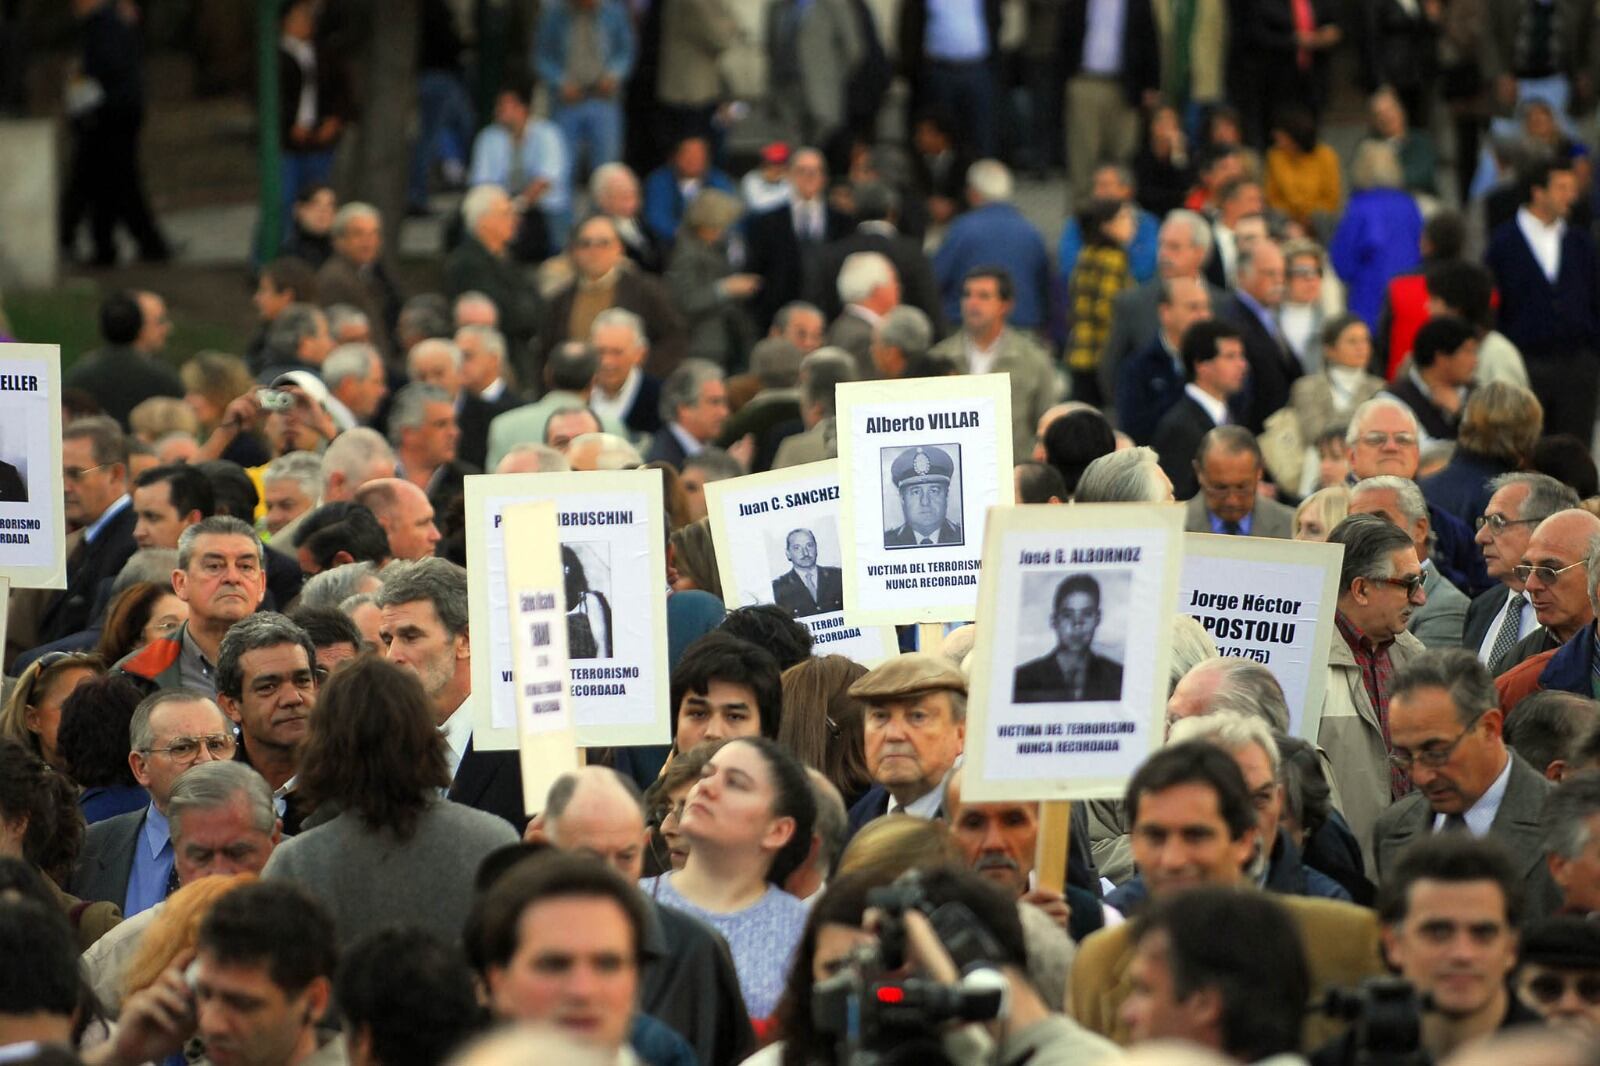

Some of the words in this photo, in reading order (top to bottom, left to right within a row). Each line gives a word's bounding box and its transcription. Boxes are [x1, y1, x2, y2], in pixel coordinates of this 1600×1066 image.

[0, 375, 38, 391] ELLER
[866, 416, 925, 433] Alberto
[927, 411, 980, 430] VILLAR
[739, 501, 769, 516] Juan
[771, 497, 784, 510] C.
[785, 485, 840, 508] SANCHEZ
[0, 518, 40, 530] RORISMO
[557, 510, 633, 526] BRUSCHINI
[0, 533, 30, 544] RDADA
[1070, 546, 1141, 563] ALBORNOZ
[867, 564, 908, 577] VICTIMA
[909, 563, 926, 574] DEL
[928, 560, 983, 573] TERRORISM
[885, 578, 918, 590] NUNCA
[920, 575, 977, 588] RECORDADA
[1190, 589, 1239, 611] Jorge
[1241, 594, 1302, 615] Héctor
[811, 616, 845, 631] TERROR
[813, 627, 861, 645] ECORDADA
[1215, 646, 1271, 664] 1/3/75)
[570, 667, 639, 680] TERRORISMO
[570, 684, 626, 697] ECORDADA
[997, 724, 1042, 737] VICTIMA
[1044, 723, 1063, 735] DEL
[1066, 721, 1136, 735] TERRORISMO
[1017, 741, 1053, 754] NUNCA
[1055, 739, 1120, 753] RECORDADA
